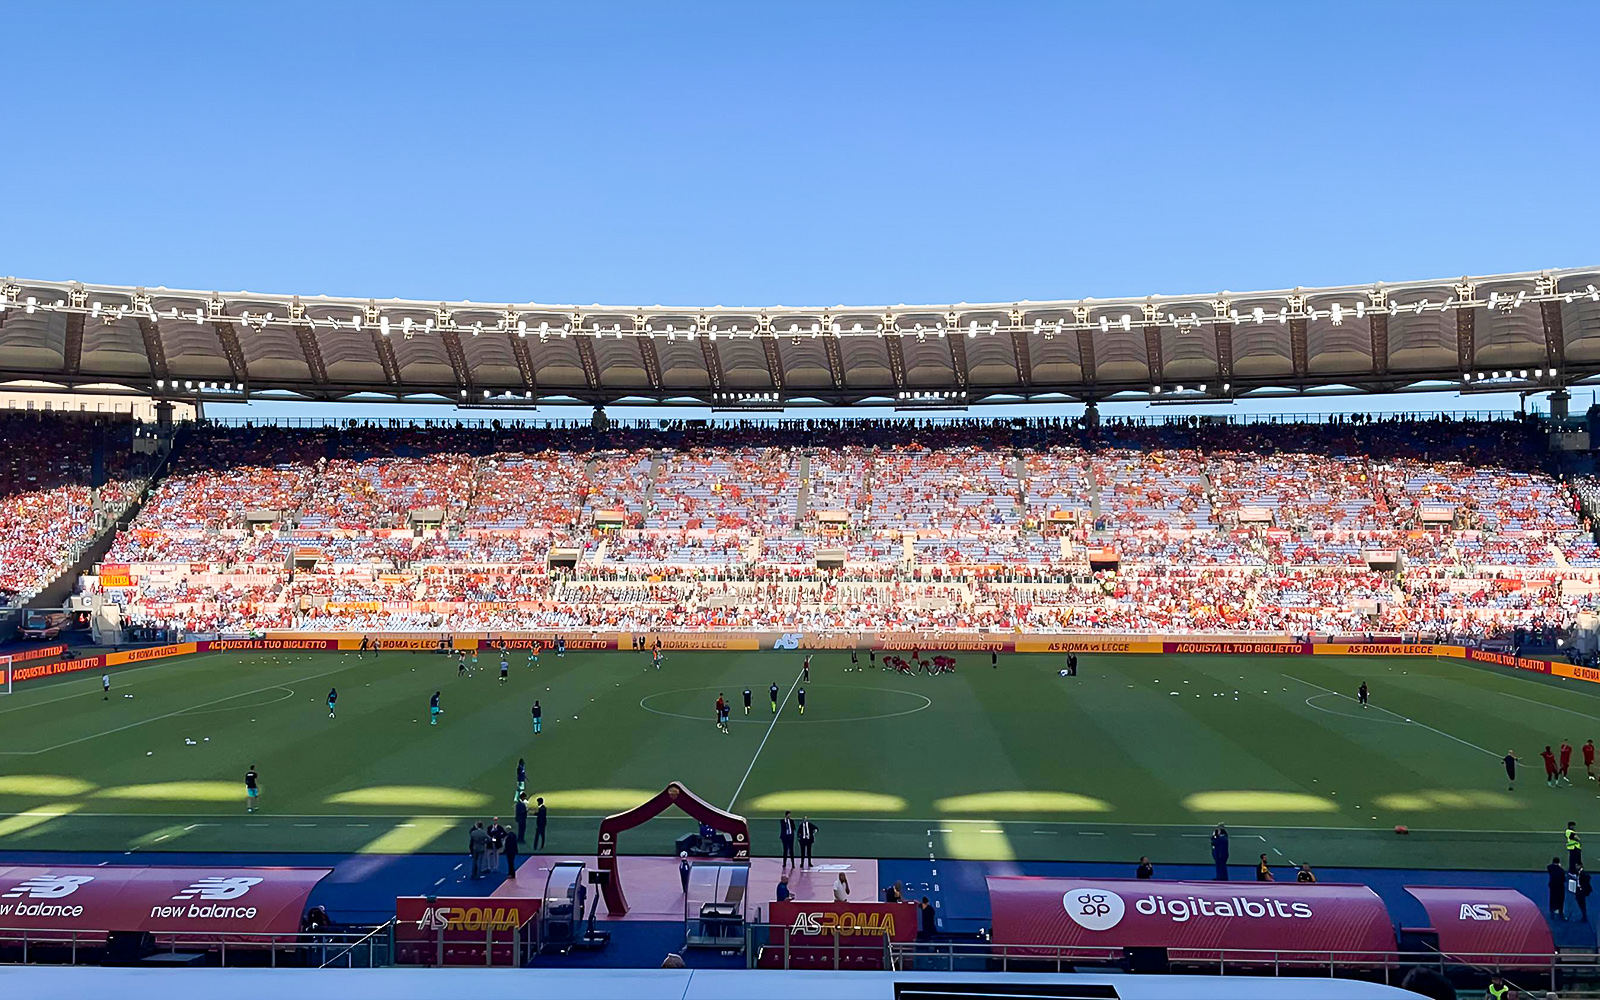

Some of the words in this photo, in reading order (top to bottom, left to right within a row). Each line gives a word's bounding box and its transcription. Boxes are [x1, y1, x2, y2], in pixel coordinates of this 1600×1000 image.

[208, 640, 252, 649] ACQUISTA
[252, 640, 263, 649] IL
[263, 640, 281, 649] TUO
[283, 640, 327, 649] BIGLIETTO
[382, 640, 409, 649] ROMA
[662, 641, 689, 649] ROMA
[701, 641, 728, 649] LECCE
[883, 642, 927, 651] ACQUISA
[1048, 642, 1060, 651] AS
[1062, 642, 1089, 652] ROMA
[1100, 643, 1129, 652] LECCE
[1176, 643, 1222, 654] ACQUISTA
[1222, 643, 1233, 654] IL
[1233, 643, 1253, 654] TUO
[1254, 644, 1302, 654] BIGLIETTO
[1347, 645, 1360, 654] AS
[1361, 645, 1391, 654] ROMA
[1403, 645, 1433, 655] LECCE
[1516, 658, 1545, 671] IGLIETTO
[15, 902, 83, 917] balance
[151, 905, 185, 918] new
[187, 903, 257, 919] balance
[1135, 895, 1313, 922] digitalbits
[1459, 903, 1511, 921] ASR
